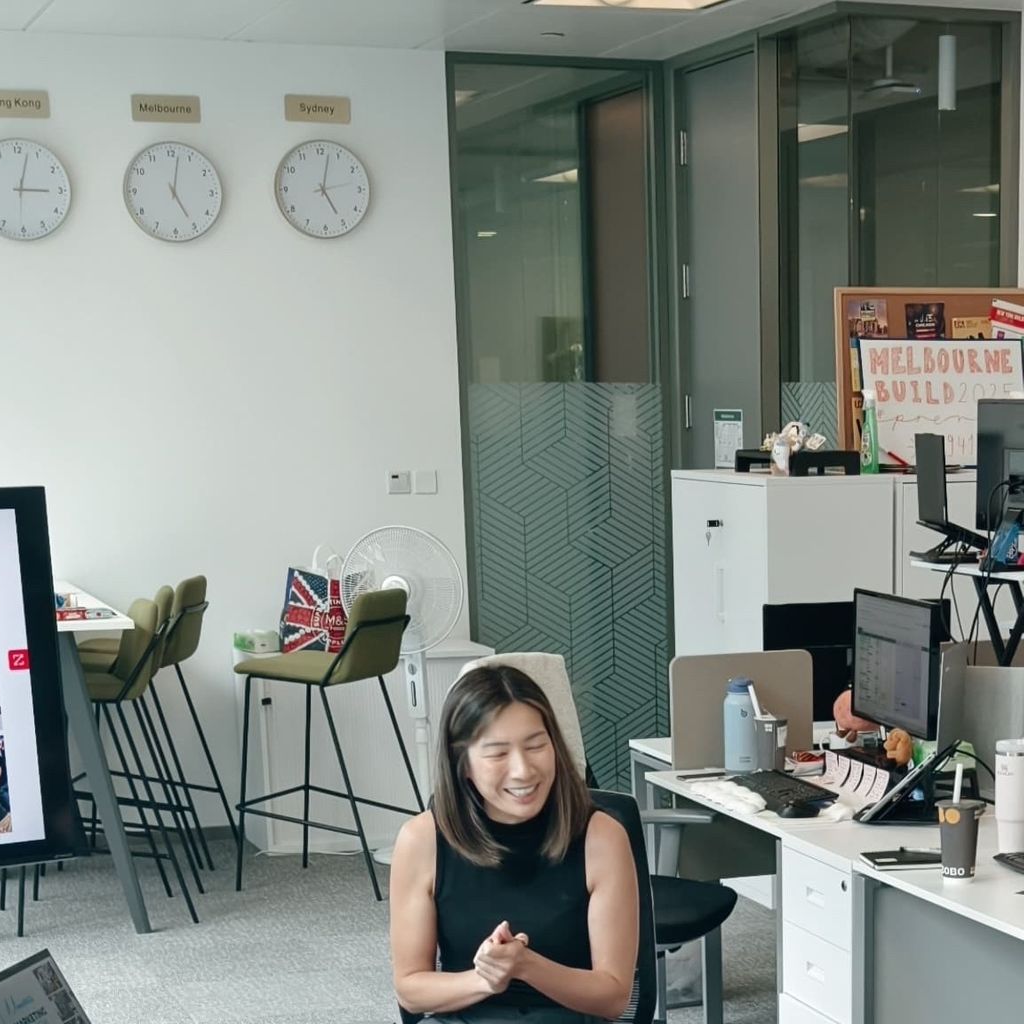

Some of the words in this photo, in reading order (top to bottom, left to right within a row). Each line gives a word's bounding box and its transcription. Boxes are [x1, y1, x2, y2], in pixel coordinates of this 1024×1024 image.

[13, 98, 42, 111] Kong
[138, 102, 193, 115] Melbourne
[299, 102, 335, 116] Sydney
[13, 146, 22, 154] 12
[166, 149, 176, 158] 12
[136, 168, 145, 176] 10
[286, 166, 296, 174] 10
[869, 346, 1013, 375] MELBOURNE
[874, 380, 955, 405] BUILD
